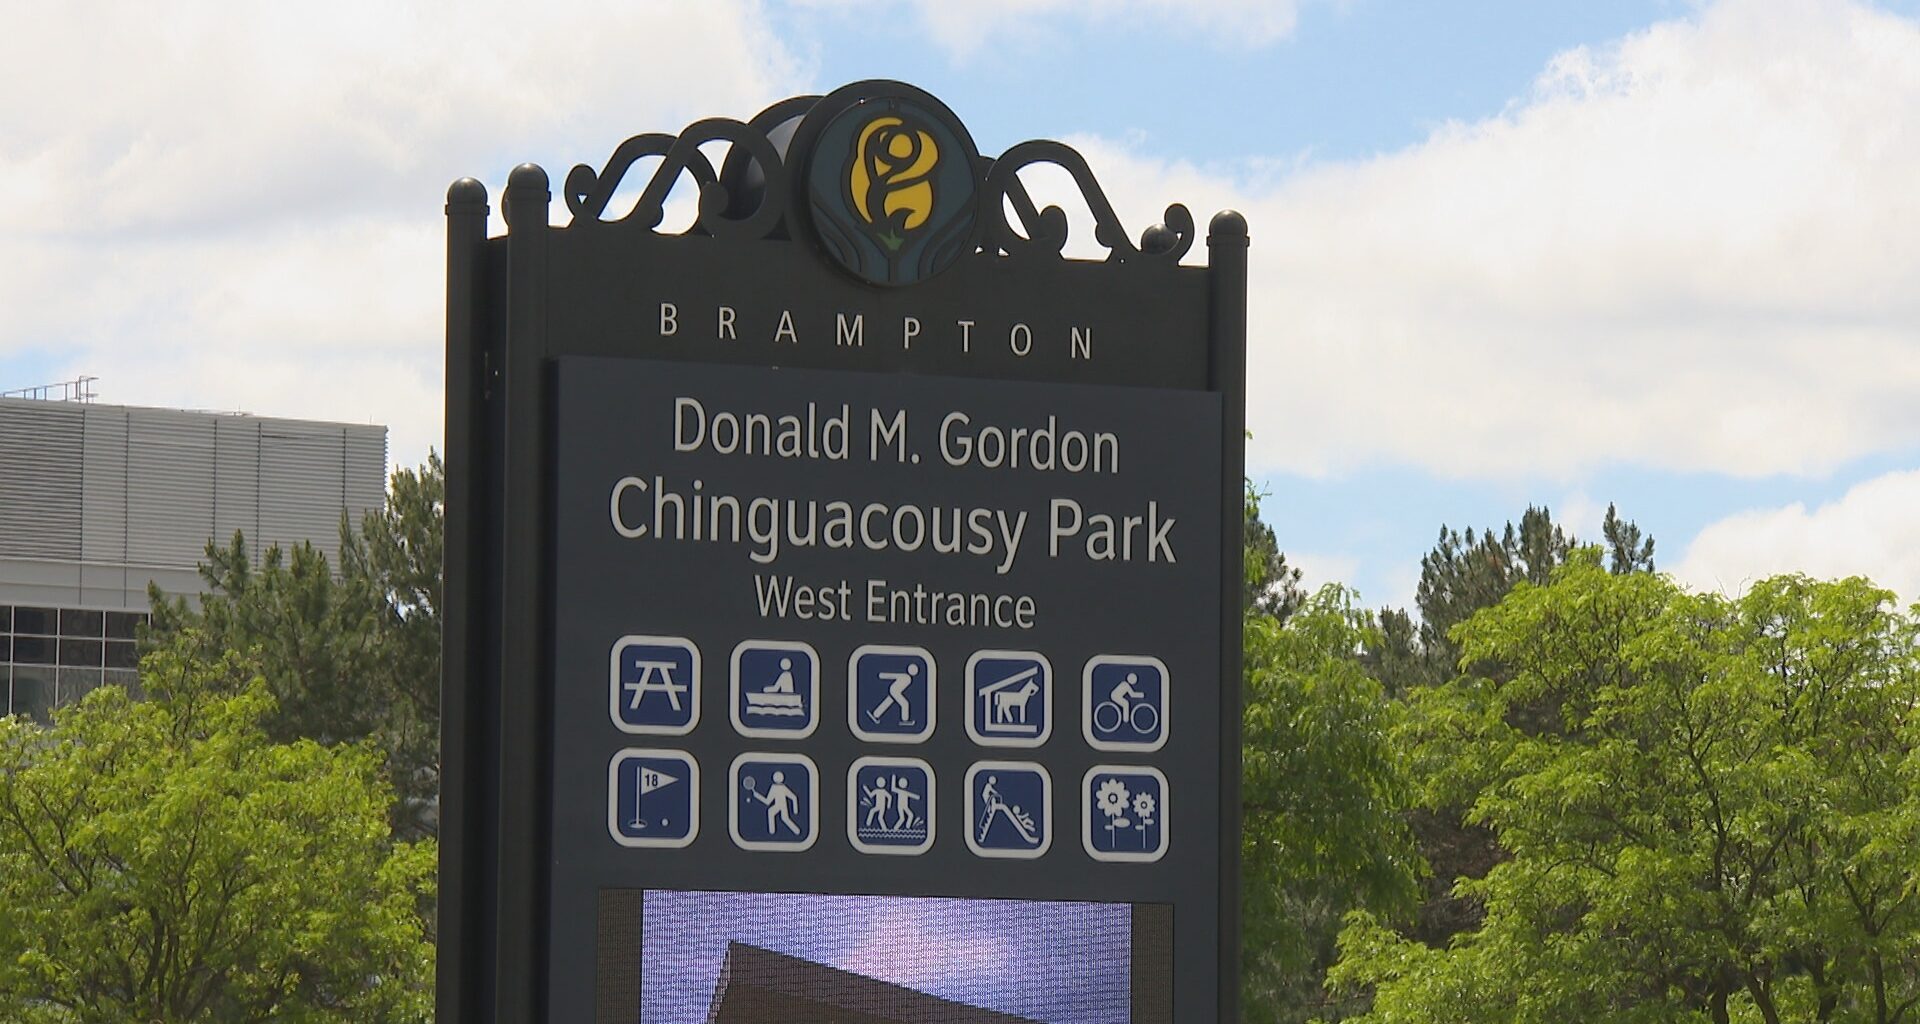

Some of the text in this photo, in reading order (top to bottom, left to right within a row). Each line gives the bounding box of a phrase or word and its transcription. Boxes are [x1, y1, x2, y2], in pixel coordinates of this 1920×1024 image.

[660, 303, 1091, 359] BRAMPTON
[674, 397, 1118, 474] Donald M. Gordon
[610, 476, 1176, 574] Chinguacousy Park
[754, 575, 1036, 628] West Entrance
[645, 774, 658, 786] 18
